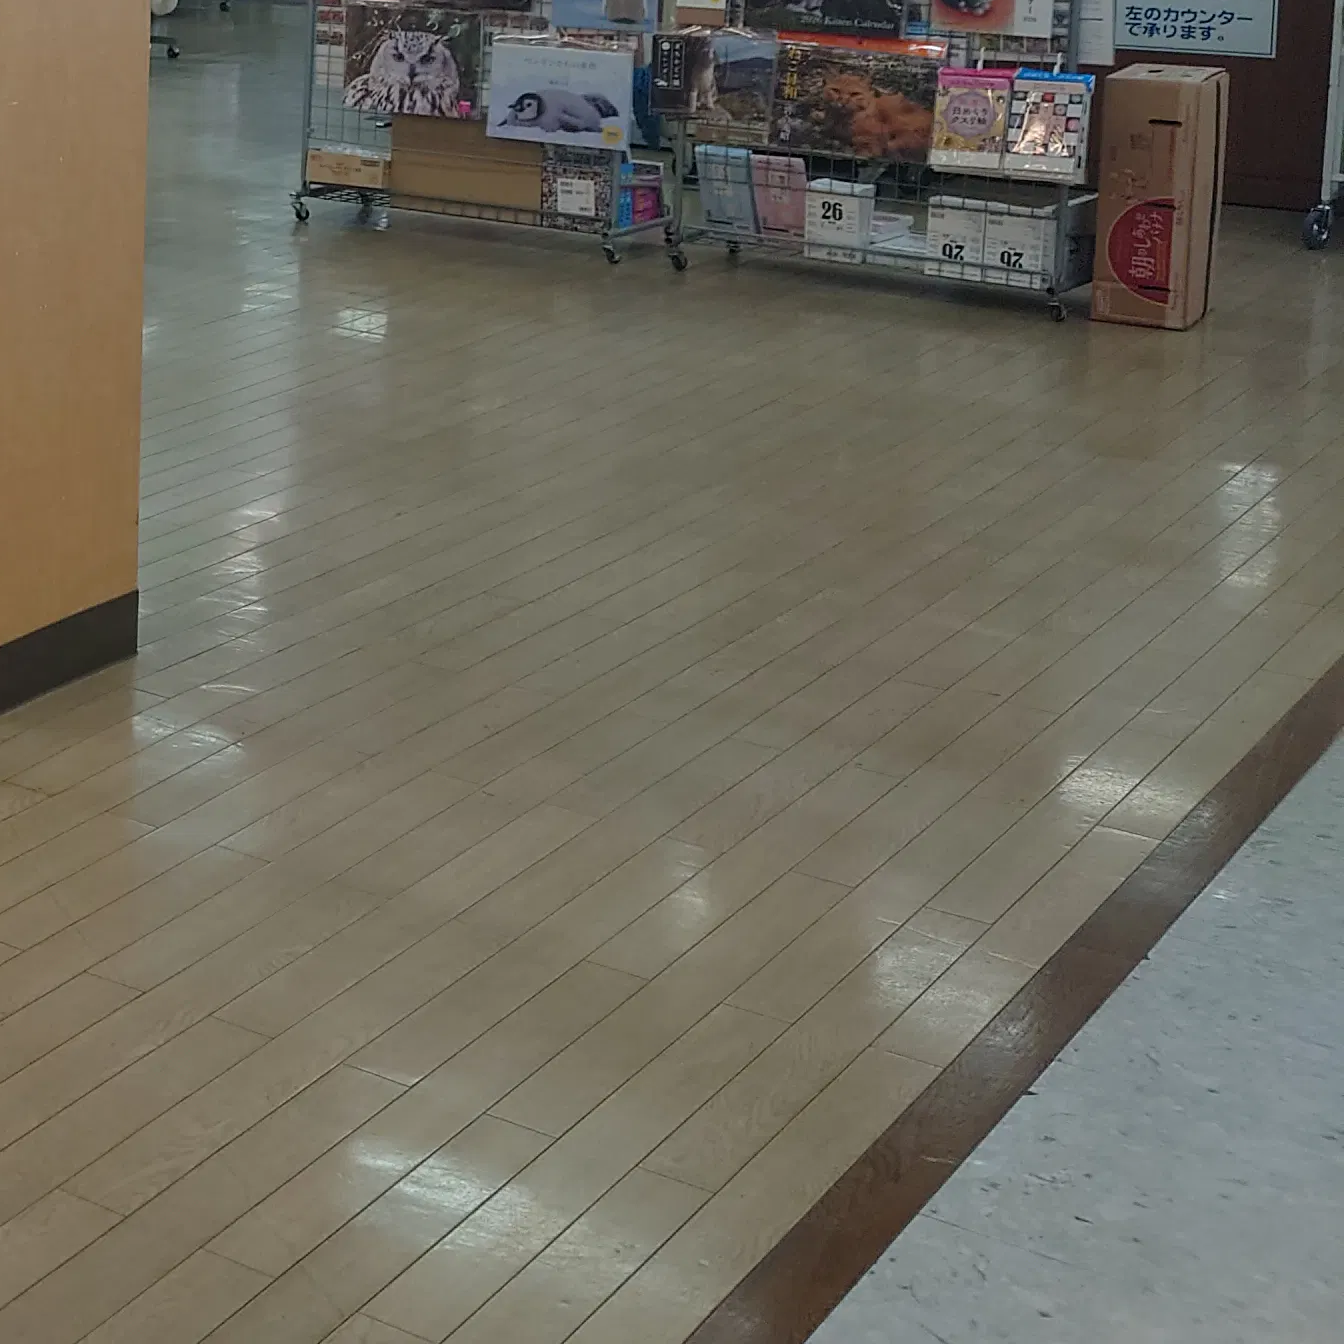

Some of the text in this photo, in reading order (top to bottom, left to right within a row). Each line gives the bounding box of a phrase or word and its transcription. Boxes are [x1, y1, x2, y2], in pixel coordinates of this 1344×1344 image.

[1125, 6, 1253, 25] 左のカウンター
[1125, 22, 1224, 41] で承ります。
[822, 201, 843, 221] 26
